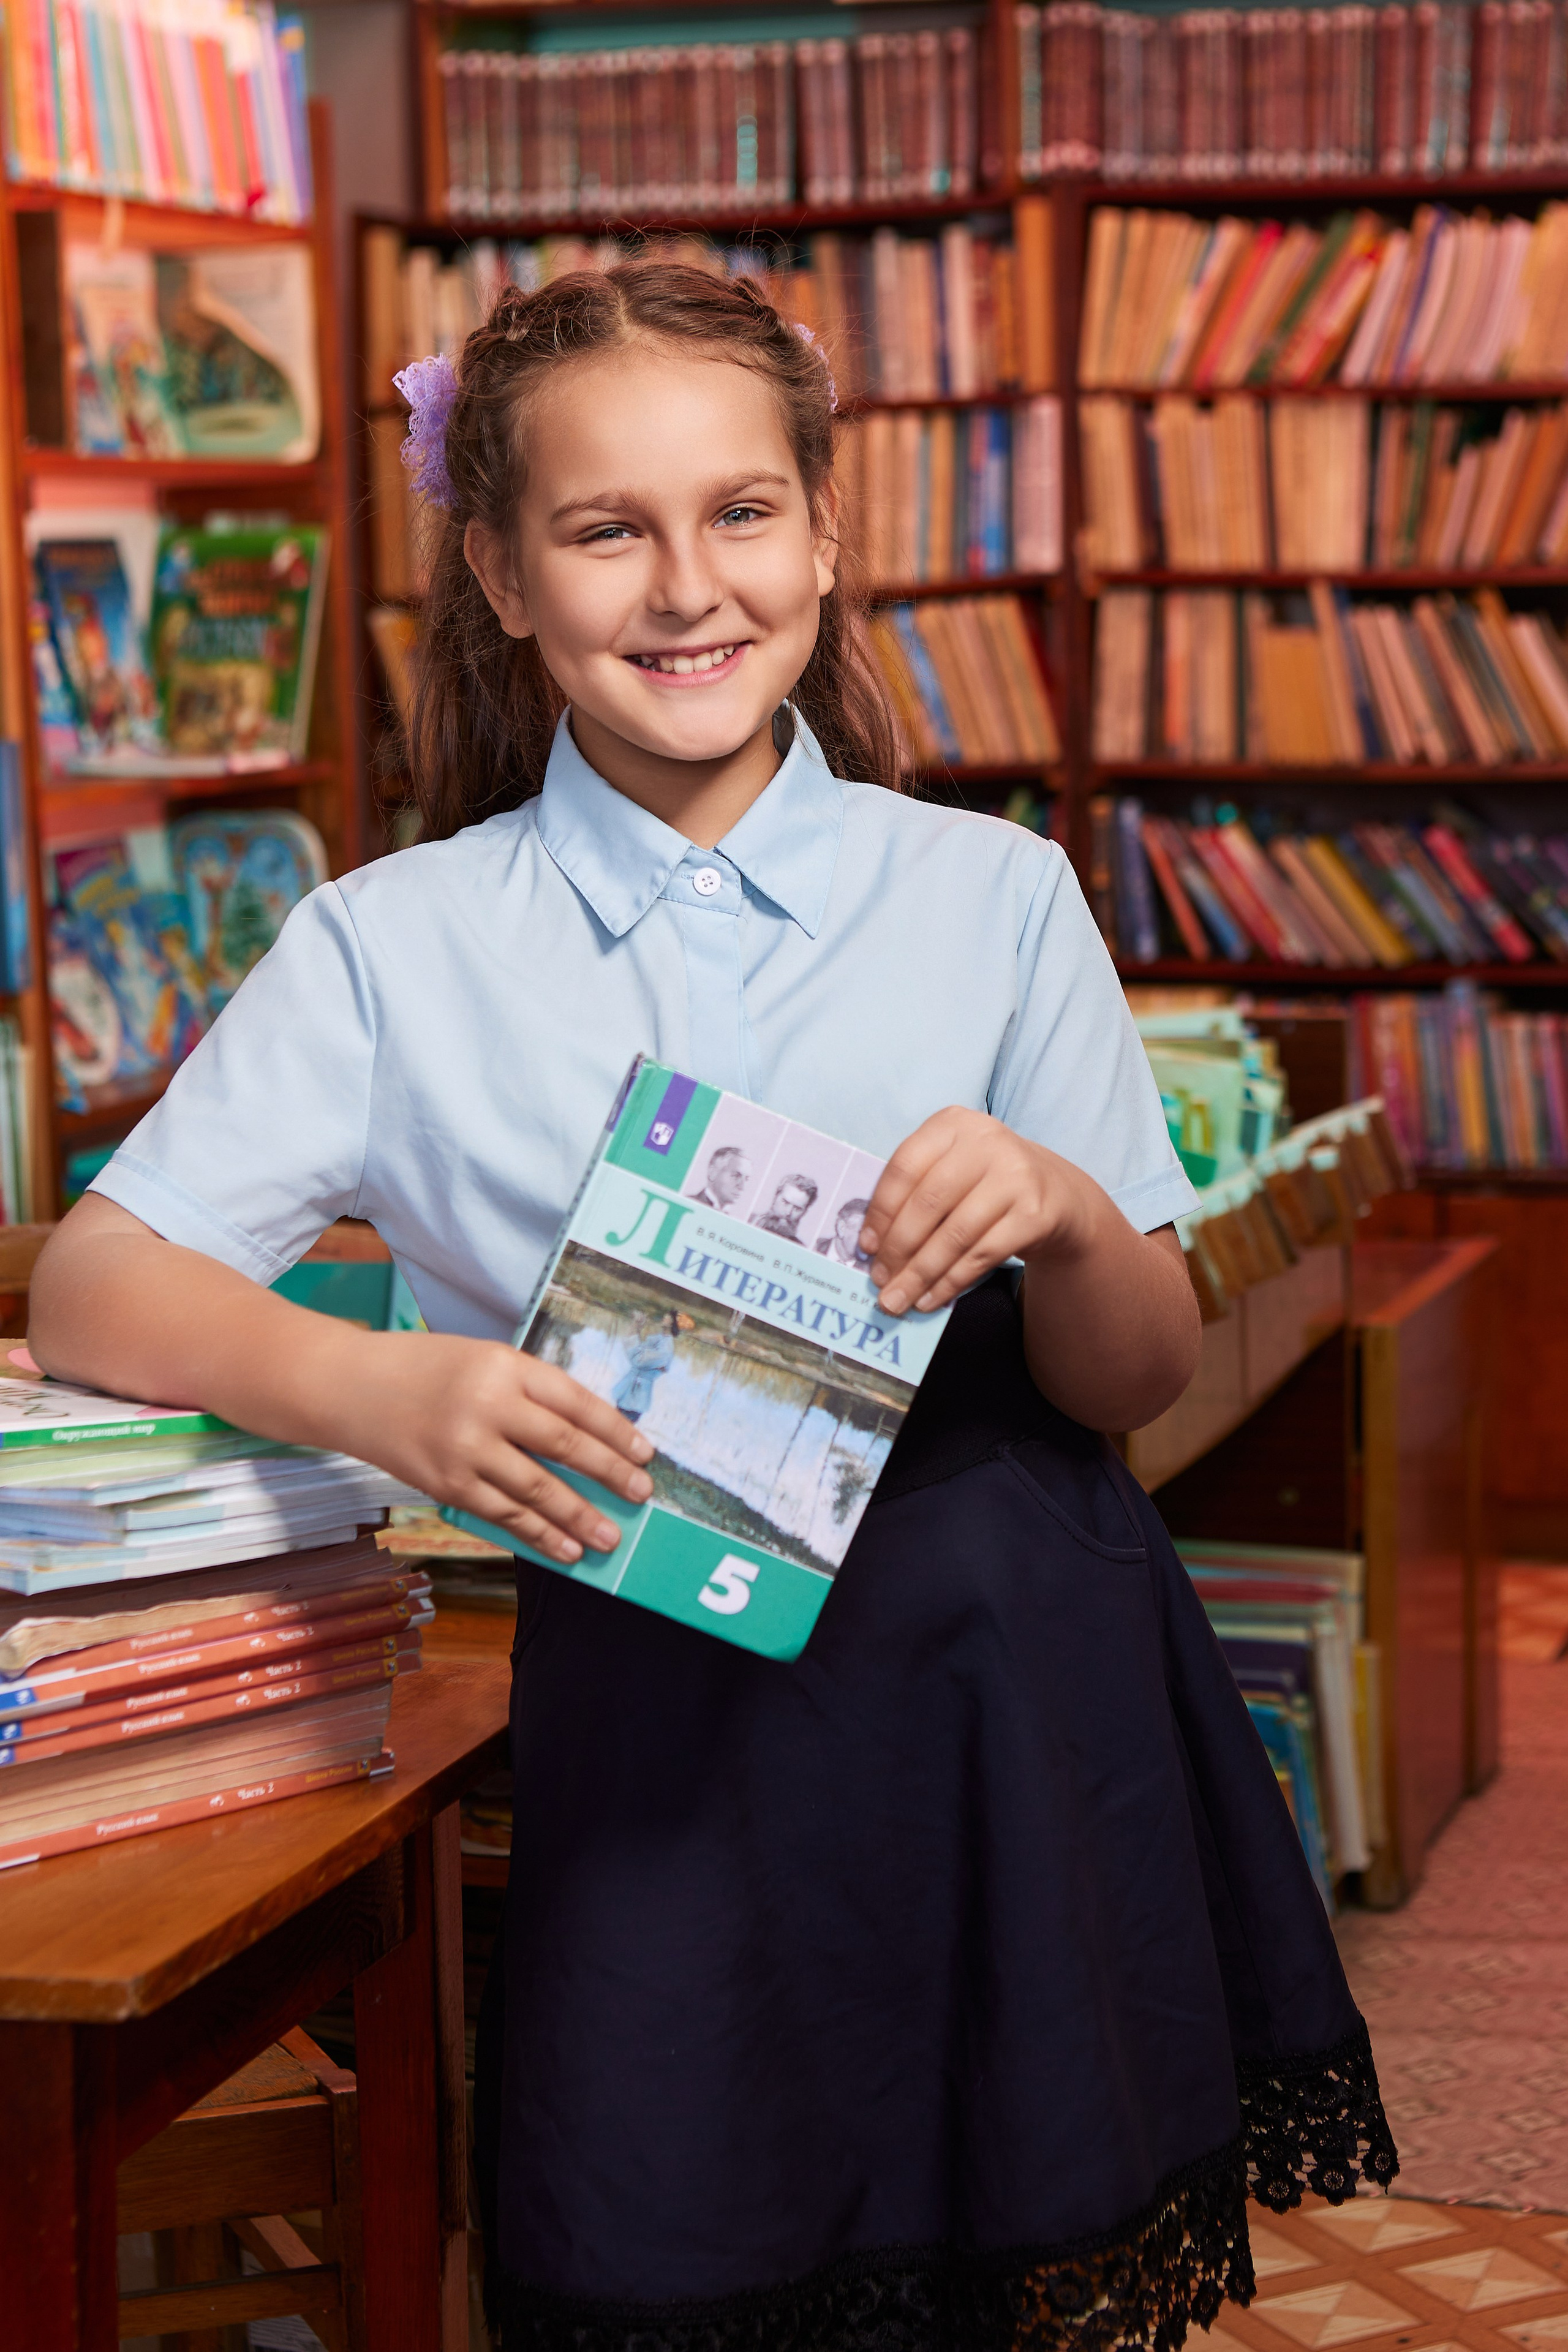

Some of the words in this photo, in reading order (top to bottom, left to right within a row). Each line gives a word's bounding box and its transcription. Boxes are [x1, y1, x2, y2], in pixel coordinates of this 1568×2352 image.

[132, 1423, 156, 1436] мир
[697, 1553, 761, 1615] 5
[130, 1633, 169, 1650] Русский
[271, 1604, 300, 1617] Часть
[138, 1657, 176, 1675] Русский
[277, 1629, 306, 1642] Часть
[126, 1691, 164, 1709] Русский
[265, 1664, 293, 1677] Часть
[121, 1716, 160, 1734] Русский
[263, 1686, 292, 1700] Часть
[96, 1817, 134, 1836] Русский
[237, 1787, 266, 1800] Часть
